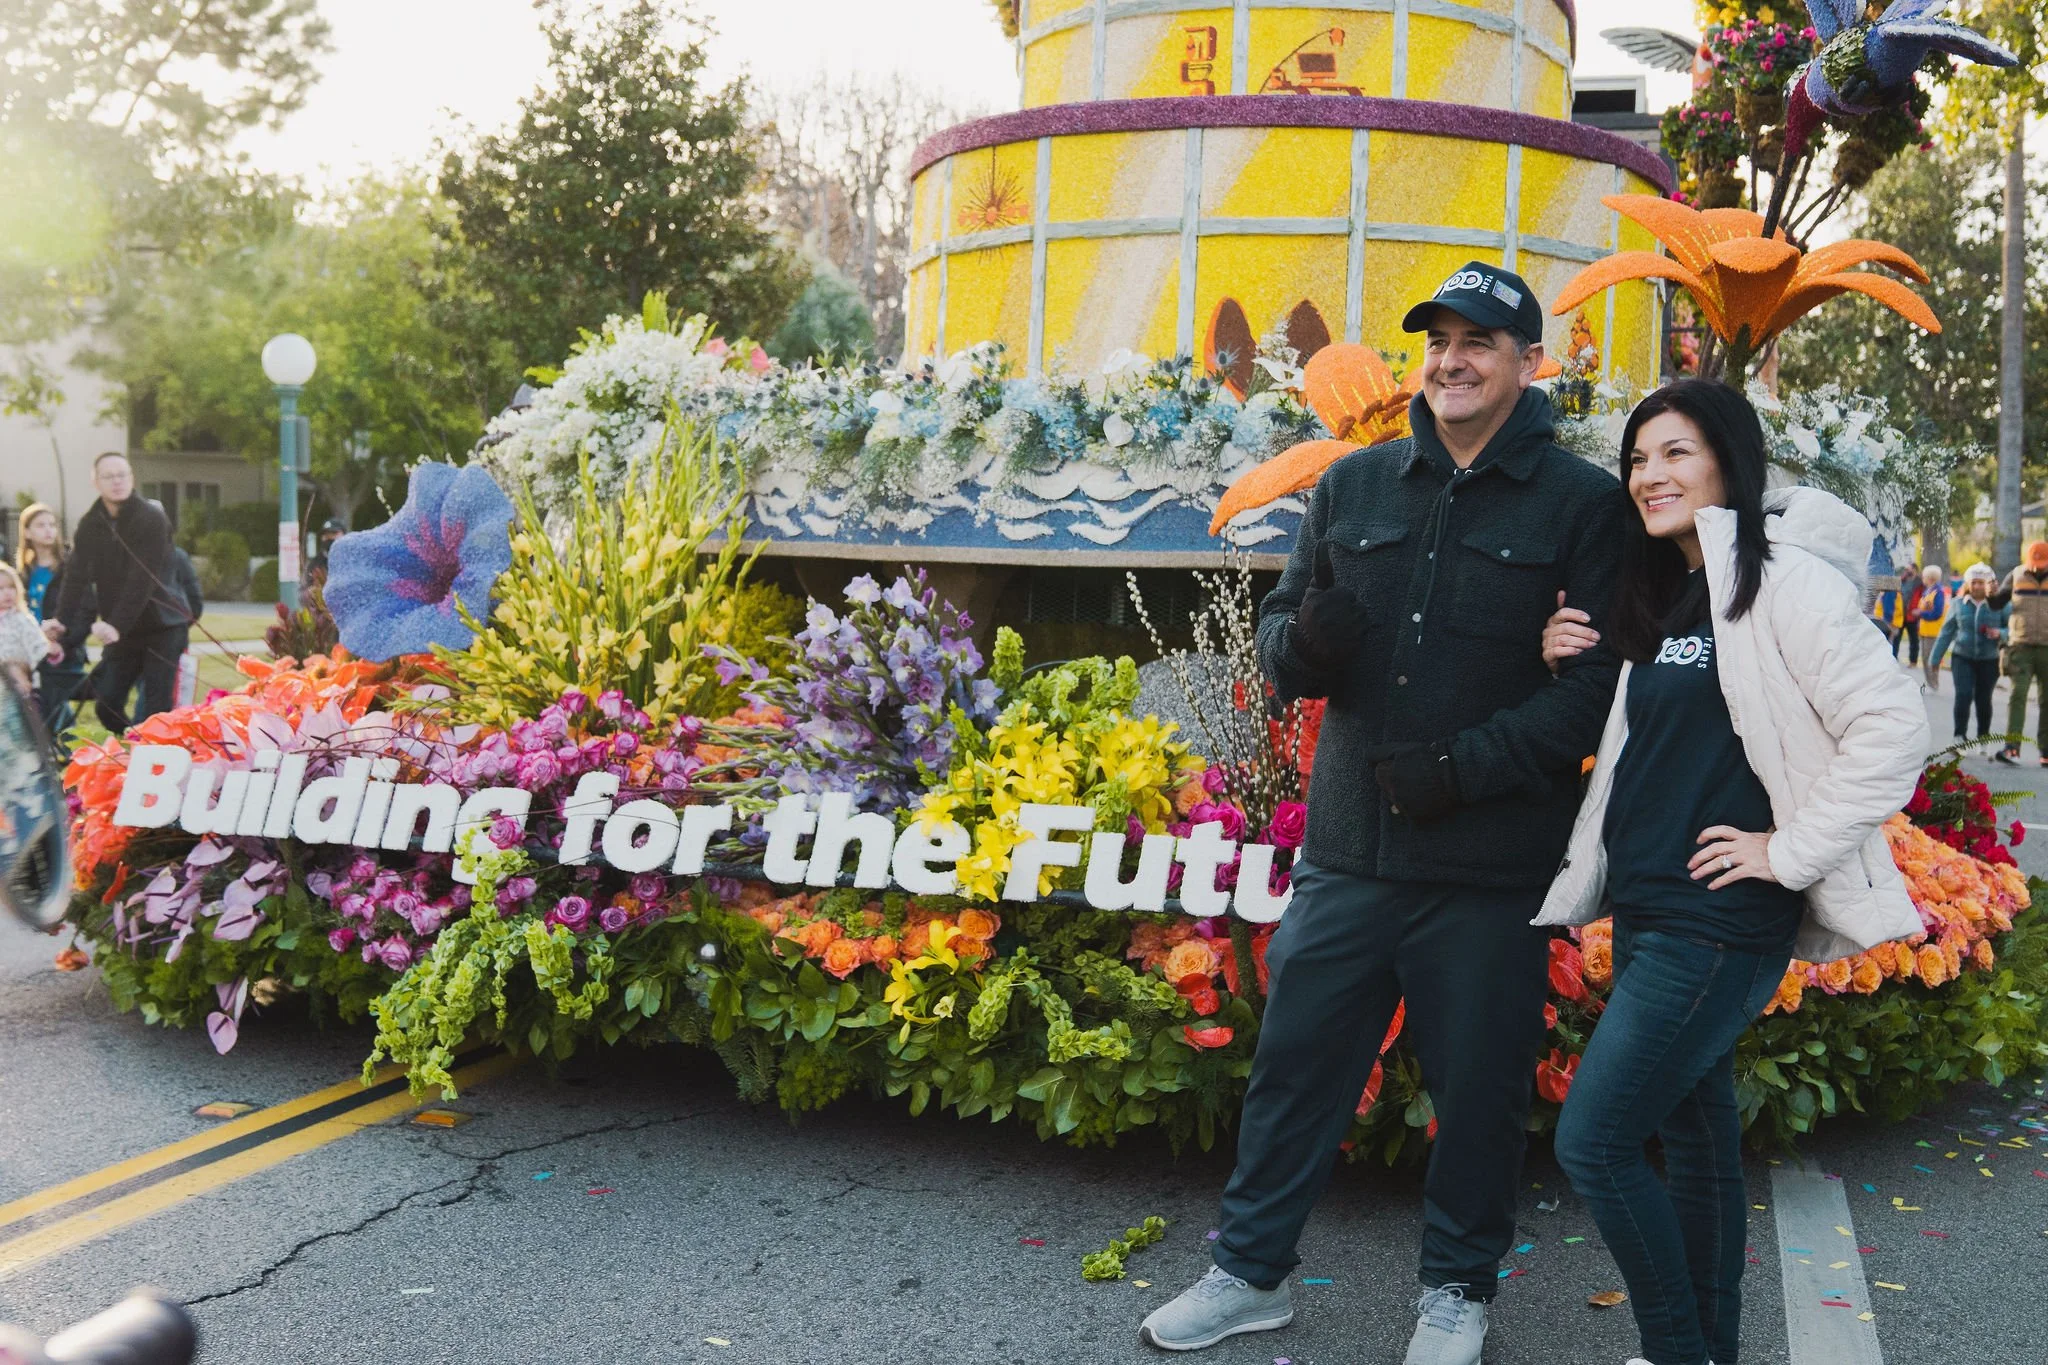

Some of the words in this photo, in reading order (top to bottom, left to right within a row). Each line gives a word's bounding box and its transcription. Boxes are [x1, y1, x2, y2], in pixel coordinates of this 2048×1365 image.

[1479, 274, 1494, 294] YEARS
[1654, 636, 1703, 665] 100
[1697, 637, 1713, 669] YEARS
[113, 744, 532, 884] Building
[558, 771, 733, 875] for
[763, 791, 972, 896] the
